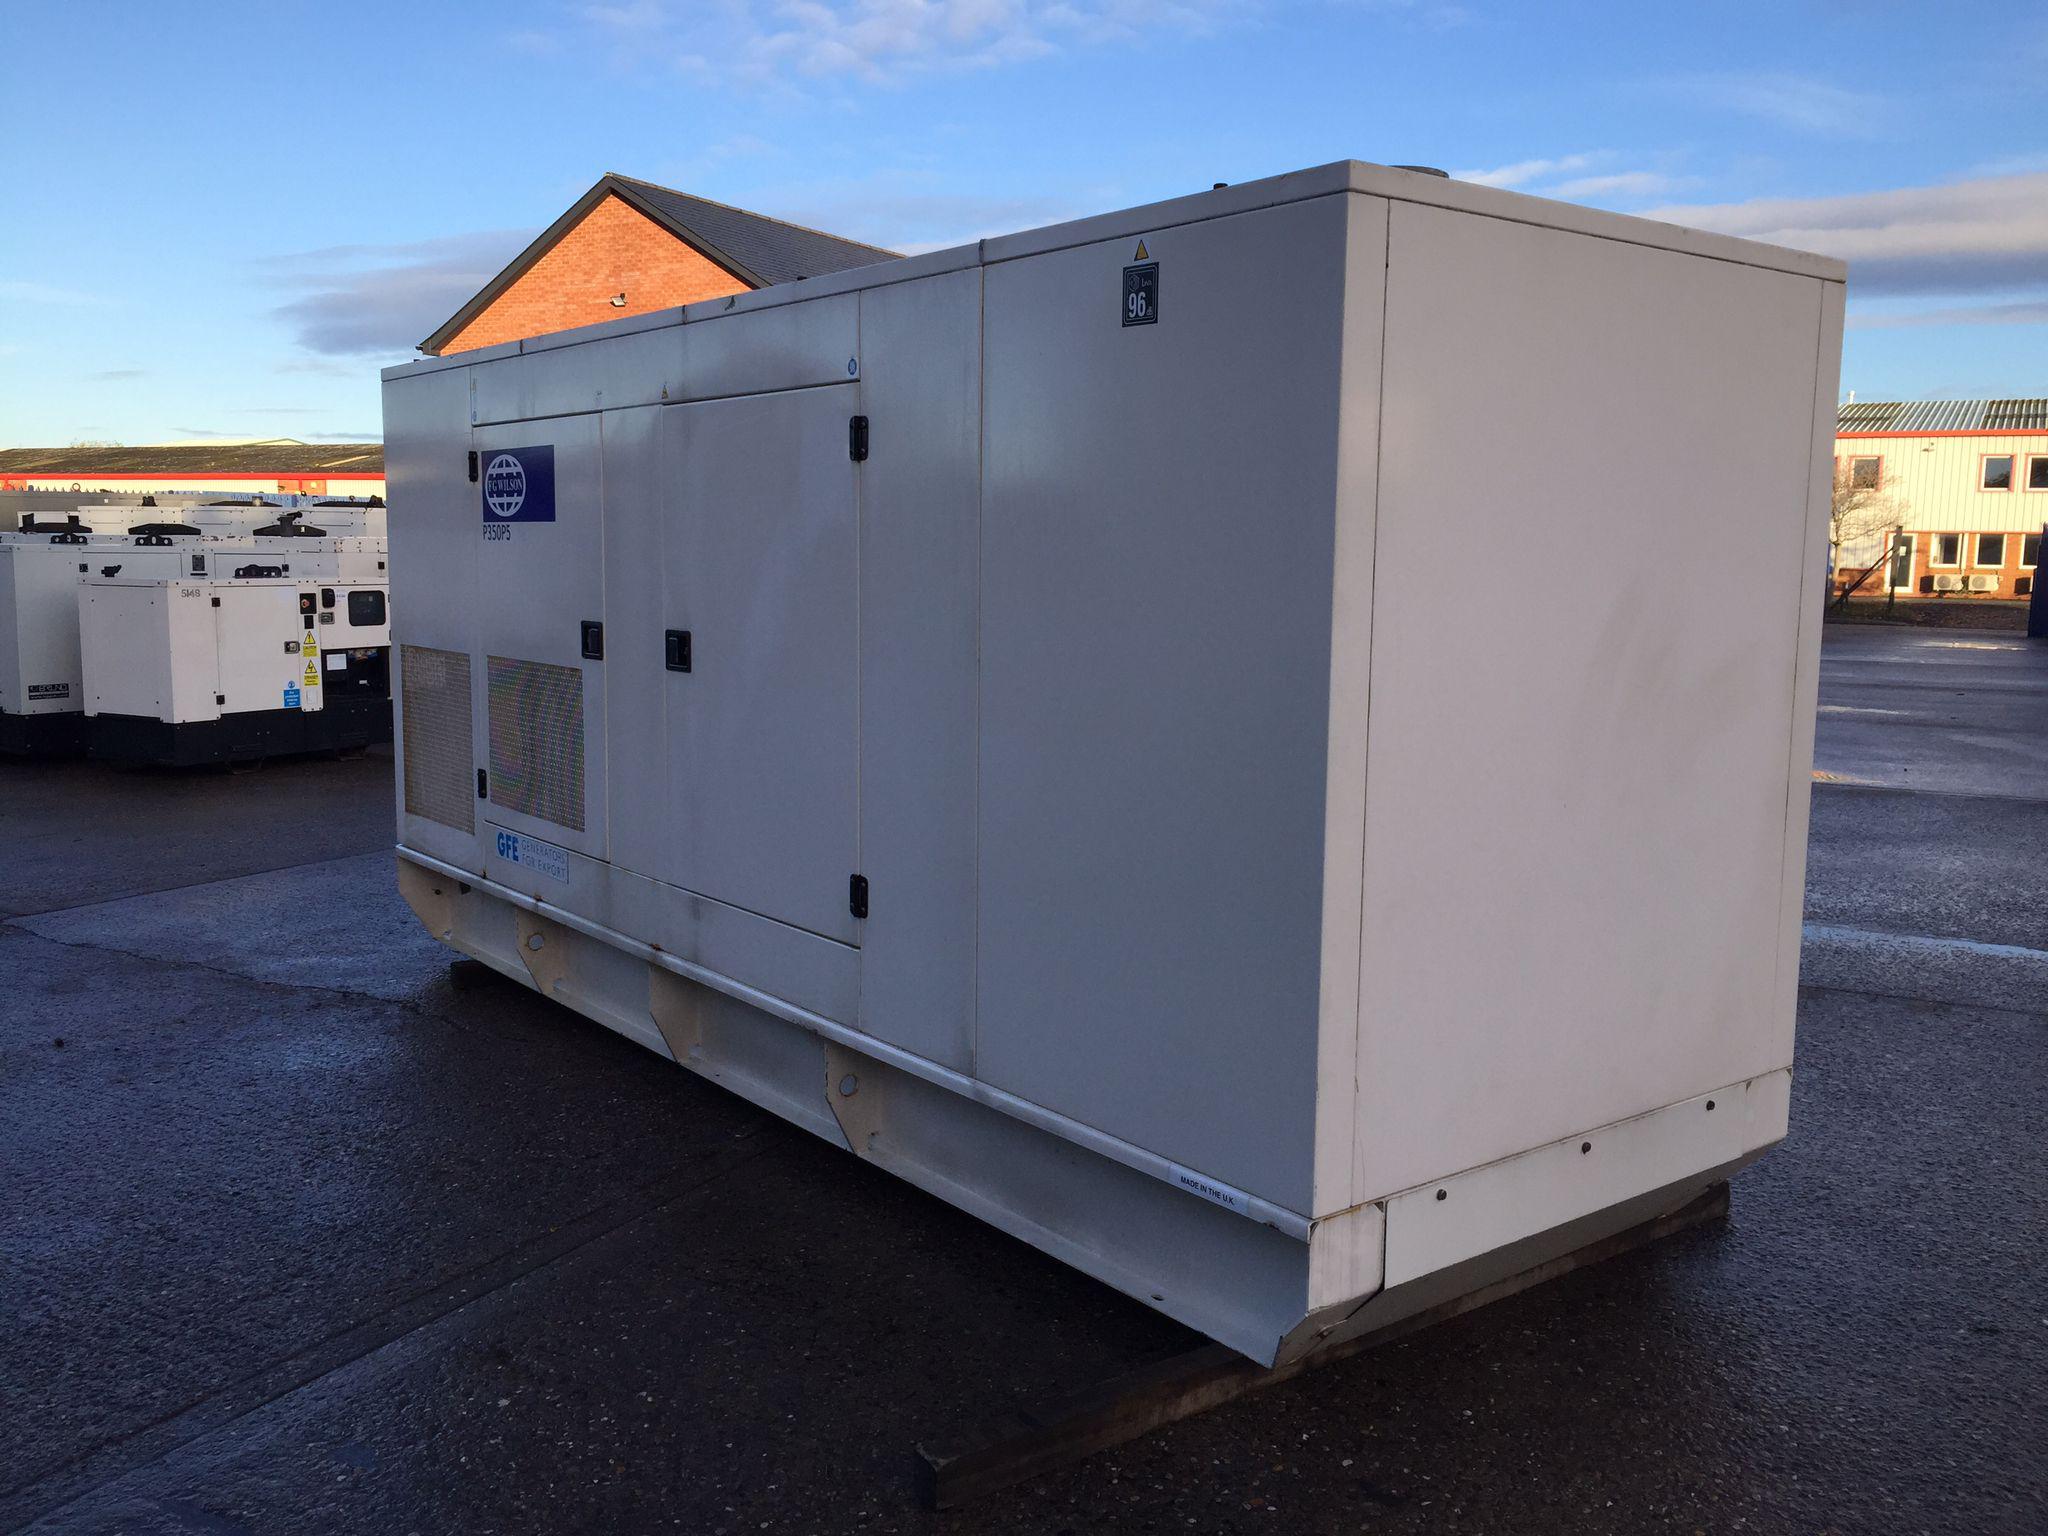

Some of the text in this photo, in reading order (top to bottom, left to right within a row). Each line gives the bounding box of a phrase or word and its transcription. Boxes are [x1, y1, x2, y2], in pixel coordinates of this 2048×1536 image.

[1128, 291, 1146, 318] 96
[498, 478, 523, 491] WILSON
[482, 524, 511, 541] P350P5
[497, 831, 519, 862] GFE
[521, 839, 567, 864] GENERATORS
[522, 853, 567, 880] FOR EXPORT
[1180, 1175, 1199, 1190] MADE
[1200, 1183, 1208, 1193] IN
[1208, 1187, 1221, 1199] THE
